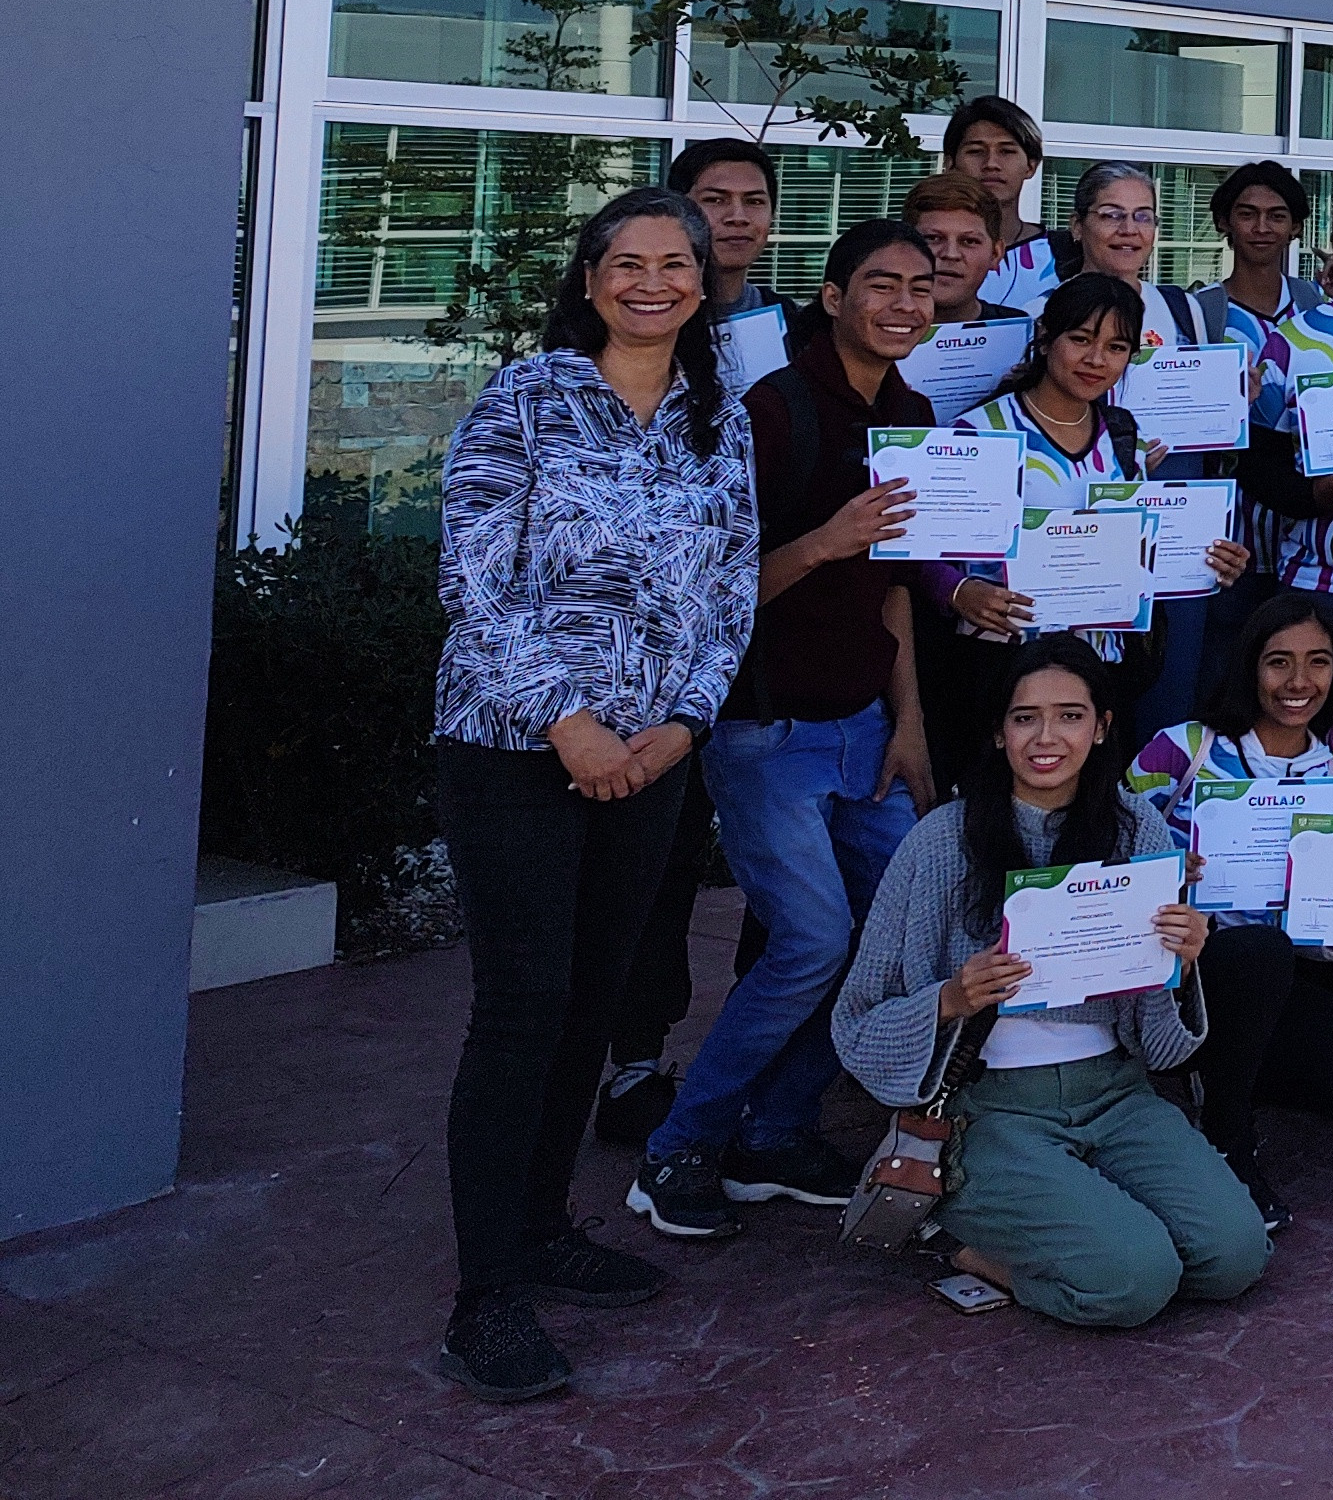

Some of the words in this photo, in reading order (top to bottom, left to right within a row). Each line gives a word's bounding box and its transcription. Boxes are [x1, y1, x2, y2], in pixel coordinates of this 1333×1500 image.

[936, 336, 987, 349] CUTLAJO
[1153, 359, 1201, 370] CUTLAJO
[926, 446, 979, 457] CUTLAJO
[1136, 497, 1187, 508] CUTLAJO
[1046, 524, 1098, 536] CUTLAJO
[1248, 795, 1306, 807] CUTLAJO
[1067, 875, 1131, 894] CUTLAJO
